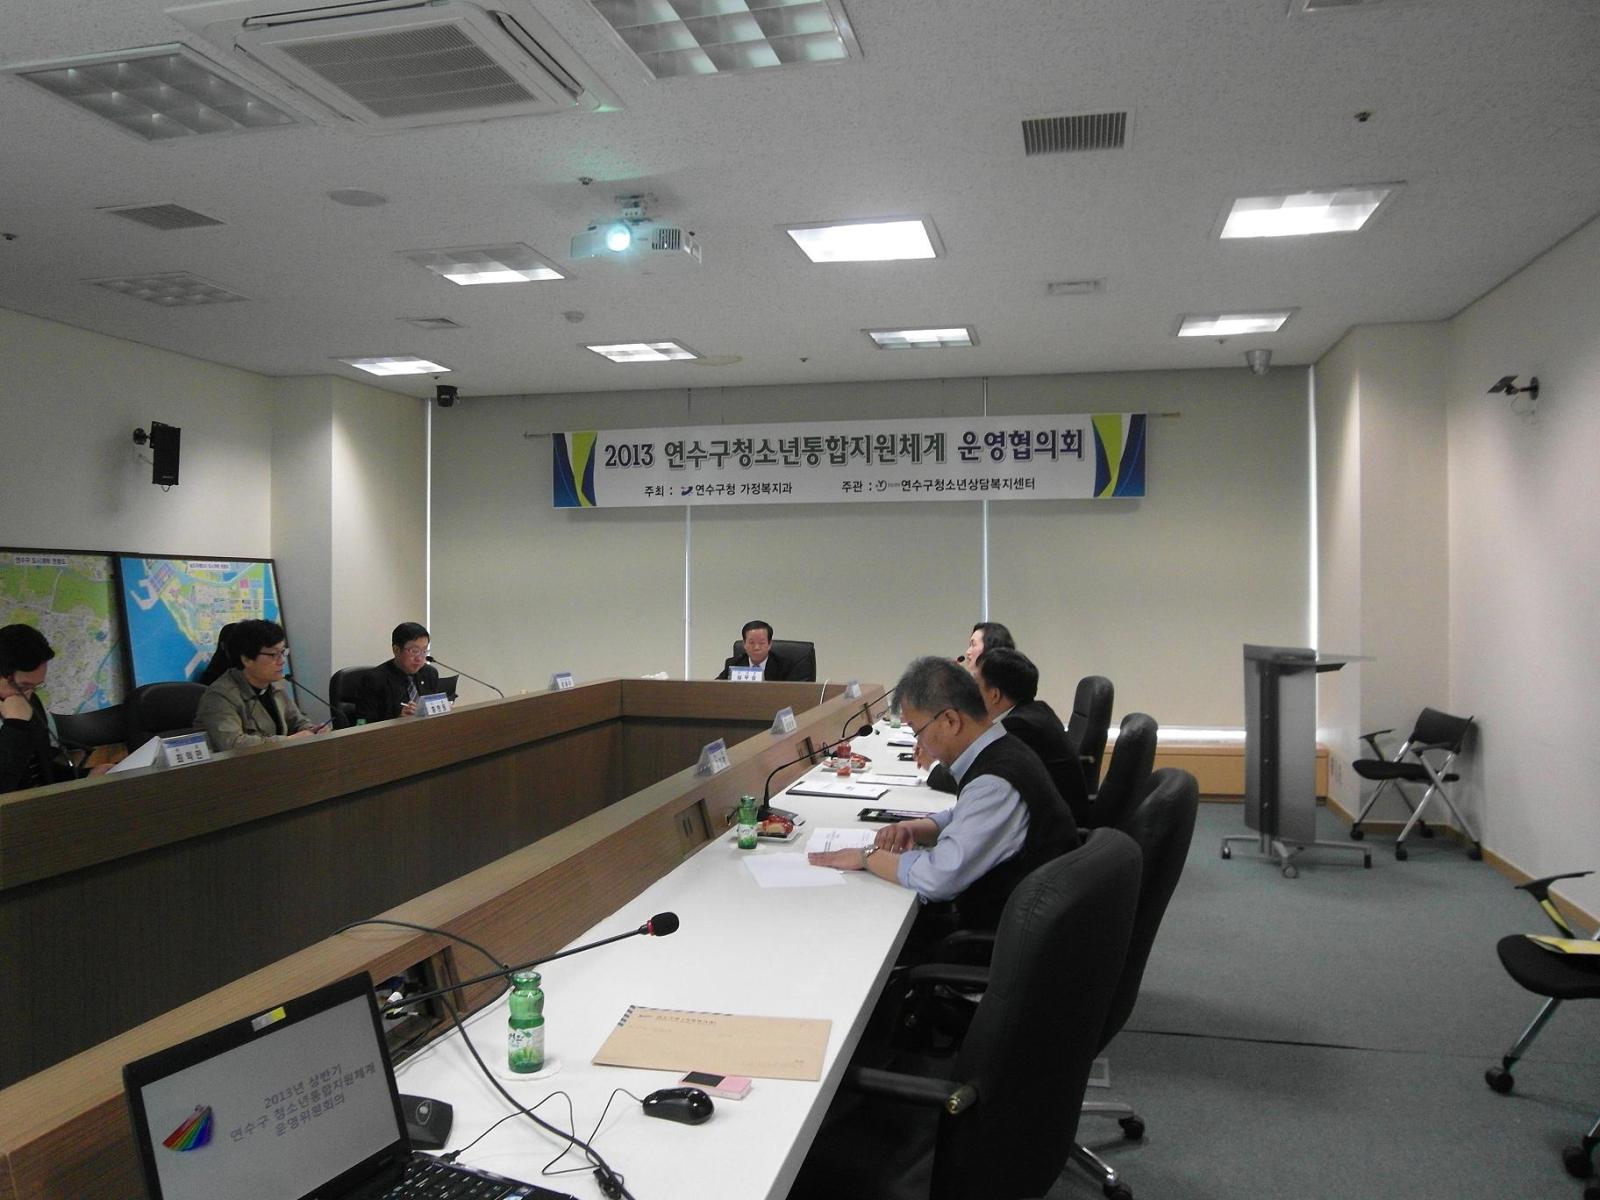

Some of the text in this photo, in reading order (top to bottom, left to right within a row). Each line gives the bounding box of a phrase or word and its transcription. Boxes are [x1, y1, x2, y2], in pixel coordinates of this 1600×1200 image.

[604, 428, 1085, 469] 2013 연수구청소년통합지원체계 운영협의회
[644, 485, 665, 497] 주최
[695, 483, 736, 496] 연수구청
[740, 482, 793, 495] 가정복지과
[842, 480, 863, 493] 주관
[901, 477, 1036, 492] 연수구청소년상담복지센터
[264, 1063, 342, 1109] 2013년 상반기
[230, 1115, 269, 1142] 연수구
